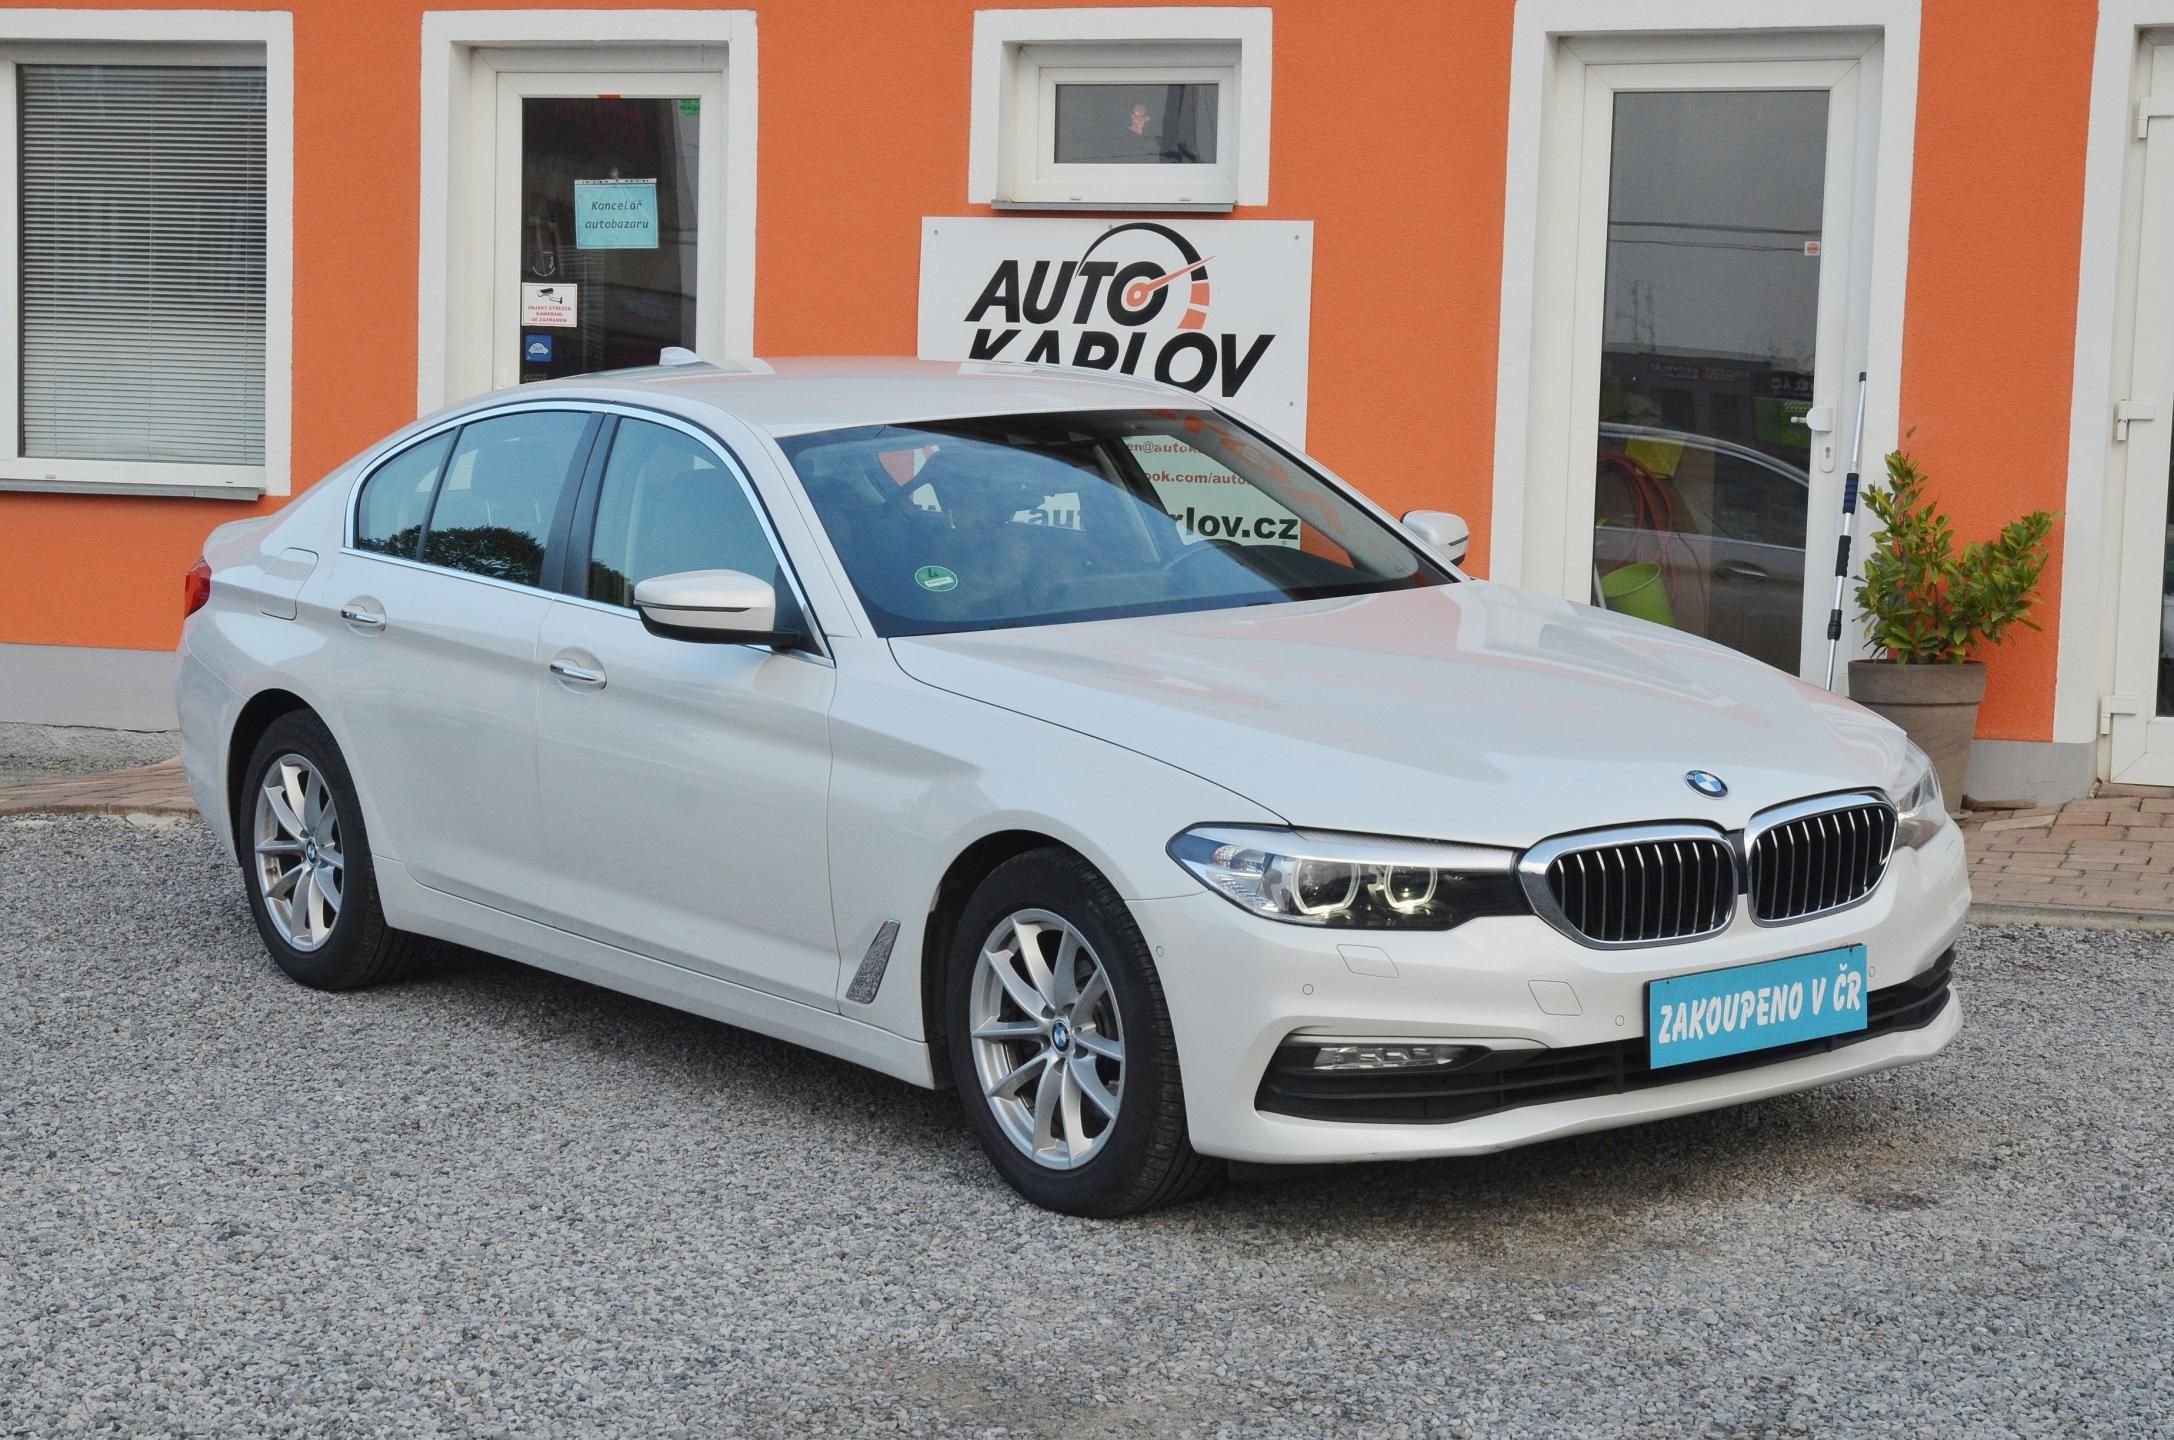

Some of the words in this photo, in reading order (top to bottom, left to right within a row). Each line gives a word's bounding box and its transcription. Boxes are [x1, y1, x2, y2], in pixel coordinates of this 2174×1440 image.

[591, 200, 642, 211] Kancelář
[585, 219, 649, 229] autobazaru
[963, 259, 1169, 327] AUTO
[1145, 471, 1250, 485] ook.com/auto
[1658, 981, 1804, 1045] ZAKOUPENO
[1811, 976, 1828, 1016] V
[1832, 962, 1863, 1012] ČR
